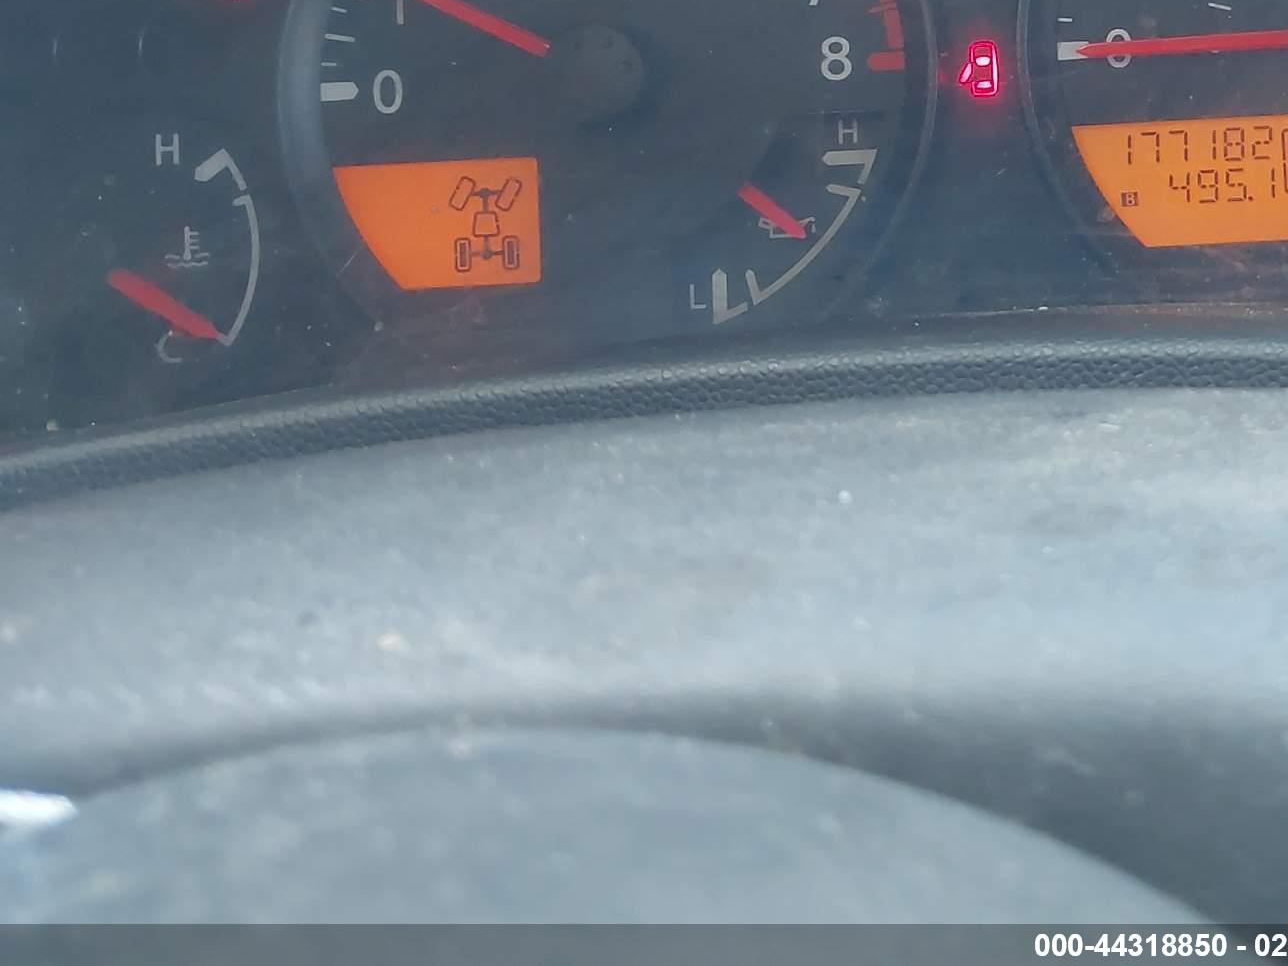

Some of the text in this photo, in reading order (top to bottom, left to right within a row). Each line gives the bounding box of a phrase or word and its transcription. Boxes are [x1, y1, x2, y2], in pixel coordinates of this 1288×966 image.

[820, 37, 852, 81] 8
[1106, 28, 1132, 68] 0
[373, 70, 403, 114] 0
[154, 134, 180, 165] H
[838, 121, 858, 143] H
[1125, 124, 1273, 165] 177182
[1168, 168, 1278, 204] 495.1
[691, 284, 706, 311] L
